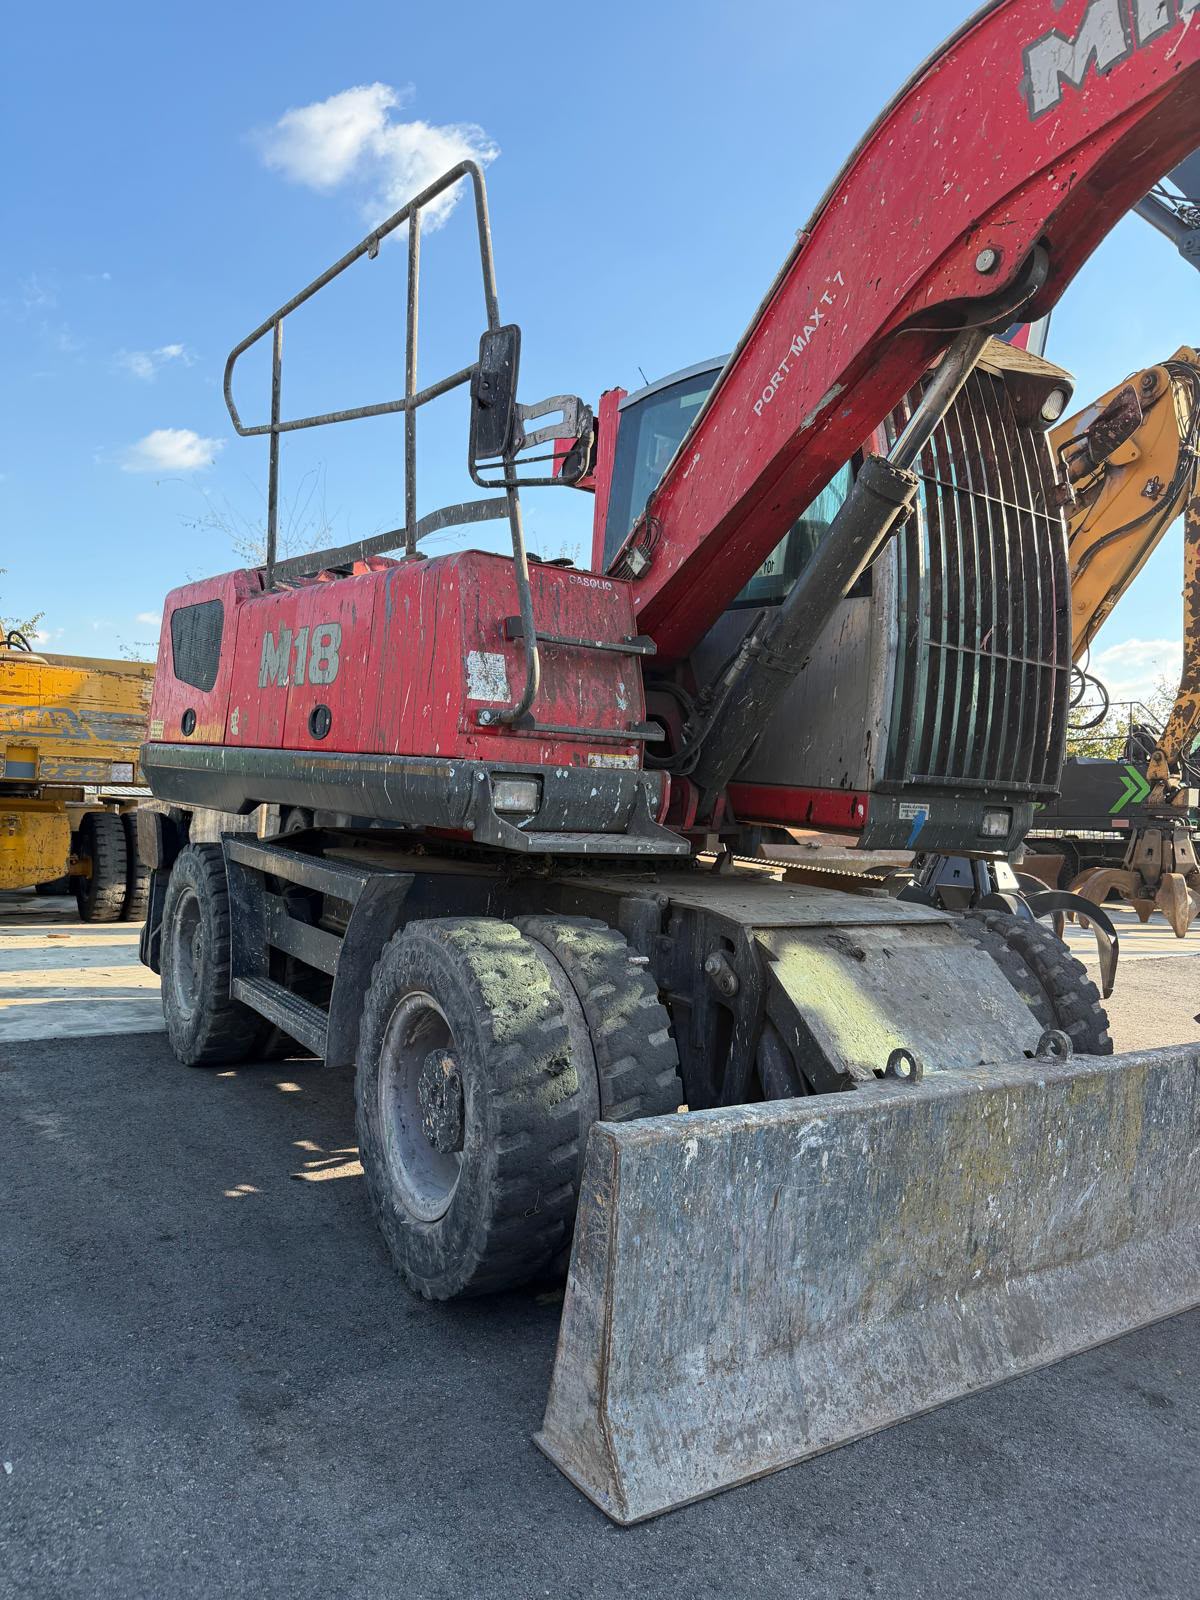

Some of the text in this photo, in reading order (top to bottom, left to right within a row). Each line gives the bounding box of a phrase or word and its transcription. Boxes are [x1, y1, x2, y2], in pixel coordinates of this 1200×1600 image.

[791, 307, 825, 357] MAX
[833, 270, 844, 286] 7
[258, 623, 342, 688] M18
